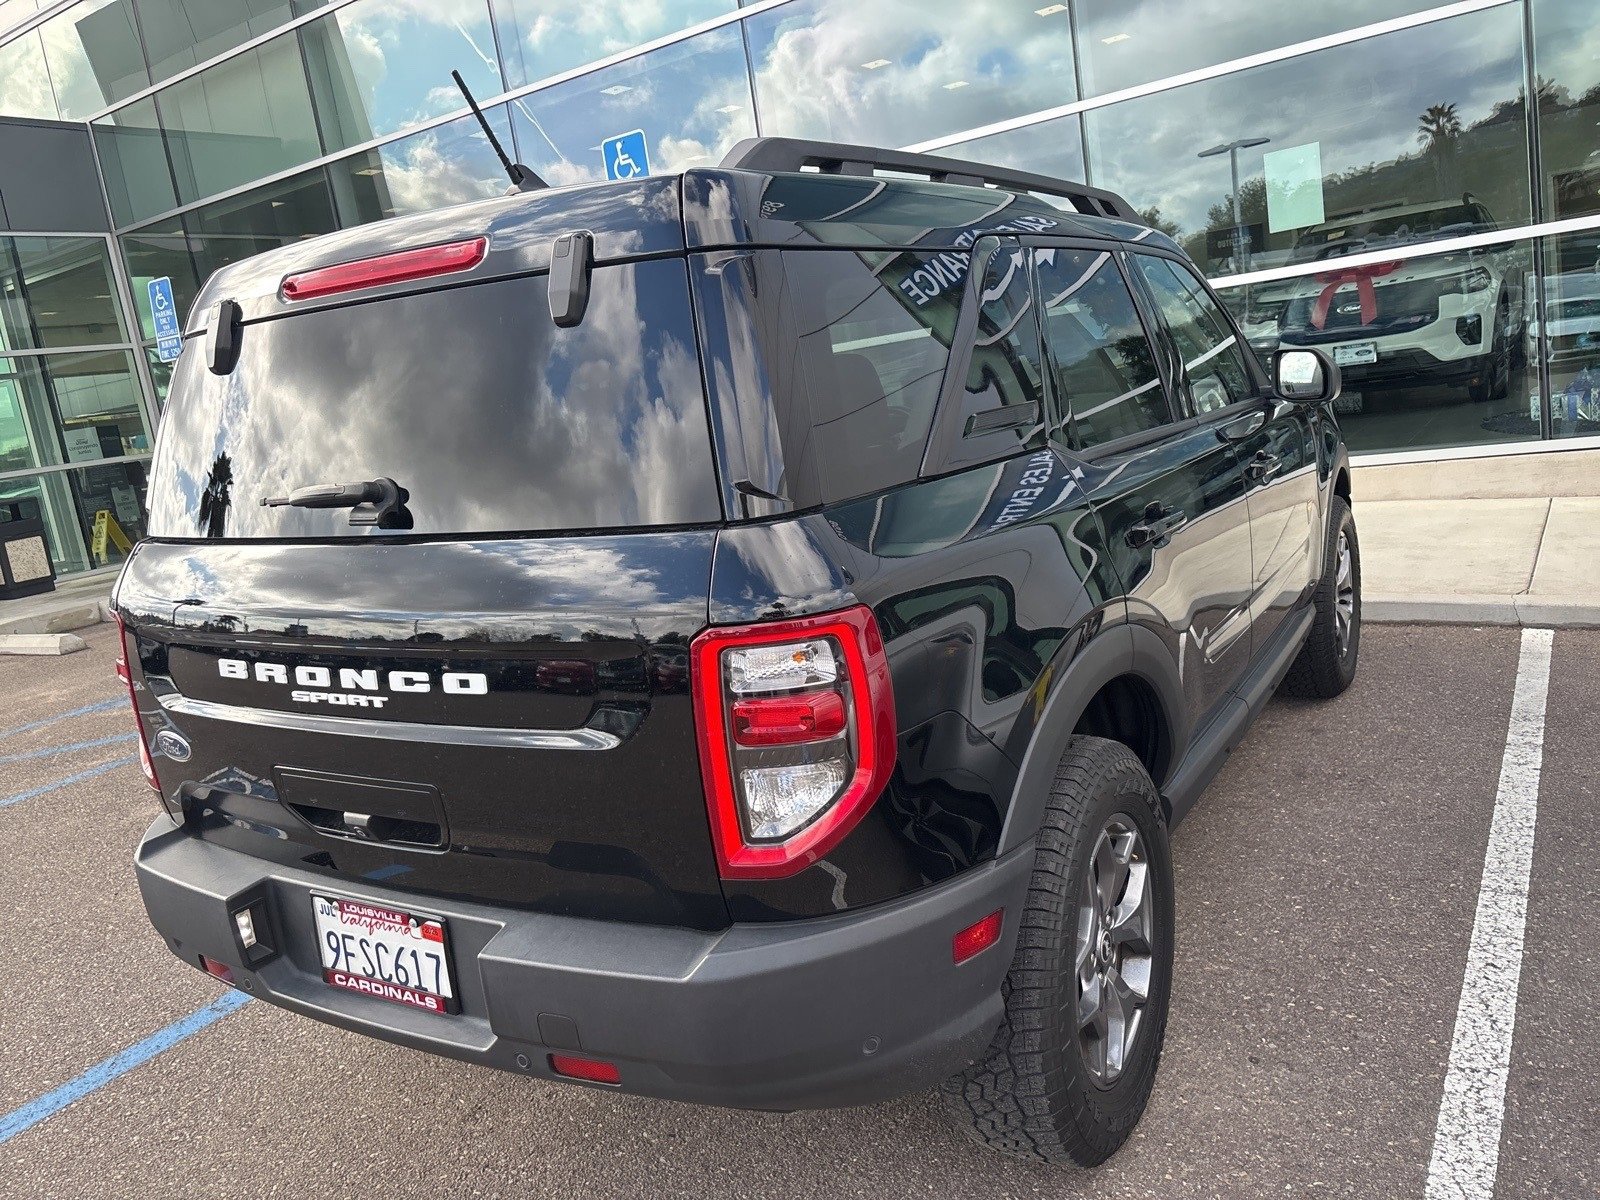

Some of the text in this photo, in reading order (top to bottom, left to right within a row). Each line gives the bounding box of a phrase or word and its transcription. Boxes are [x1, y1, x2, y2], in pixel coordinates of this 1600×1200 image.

[155, 309, 173, 318] PARKING
[160, 316, 171, 325] ONLY
[217, 658, 488, 695] BRONCO
[291, 690, 389, 708] SPORT
[161, 736, 181, 756] Ford
[320, 903, 336, 917] JUL
[344, 903, 403, 923] LOUISVILLE
[326, 930, 441, 996] 9FSC617
[334, 973, 438, 1010] CARDINALS
